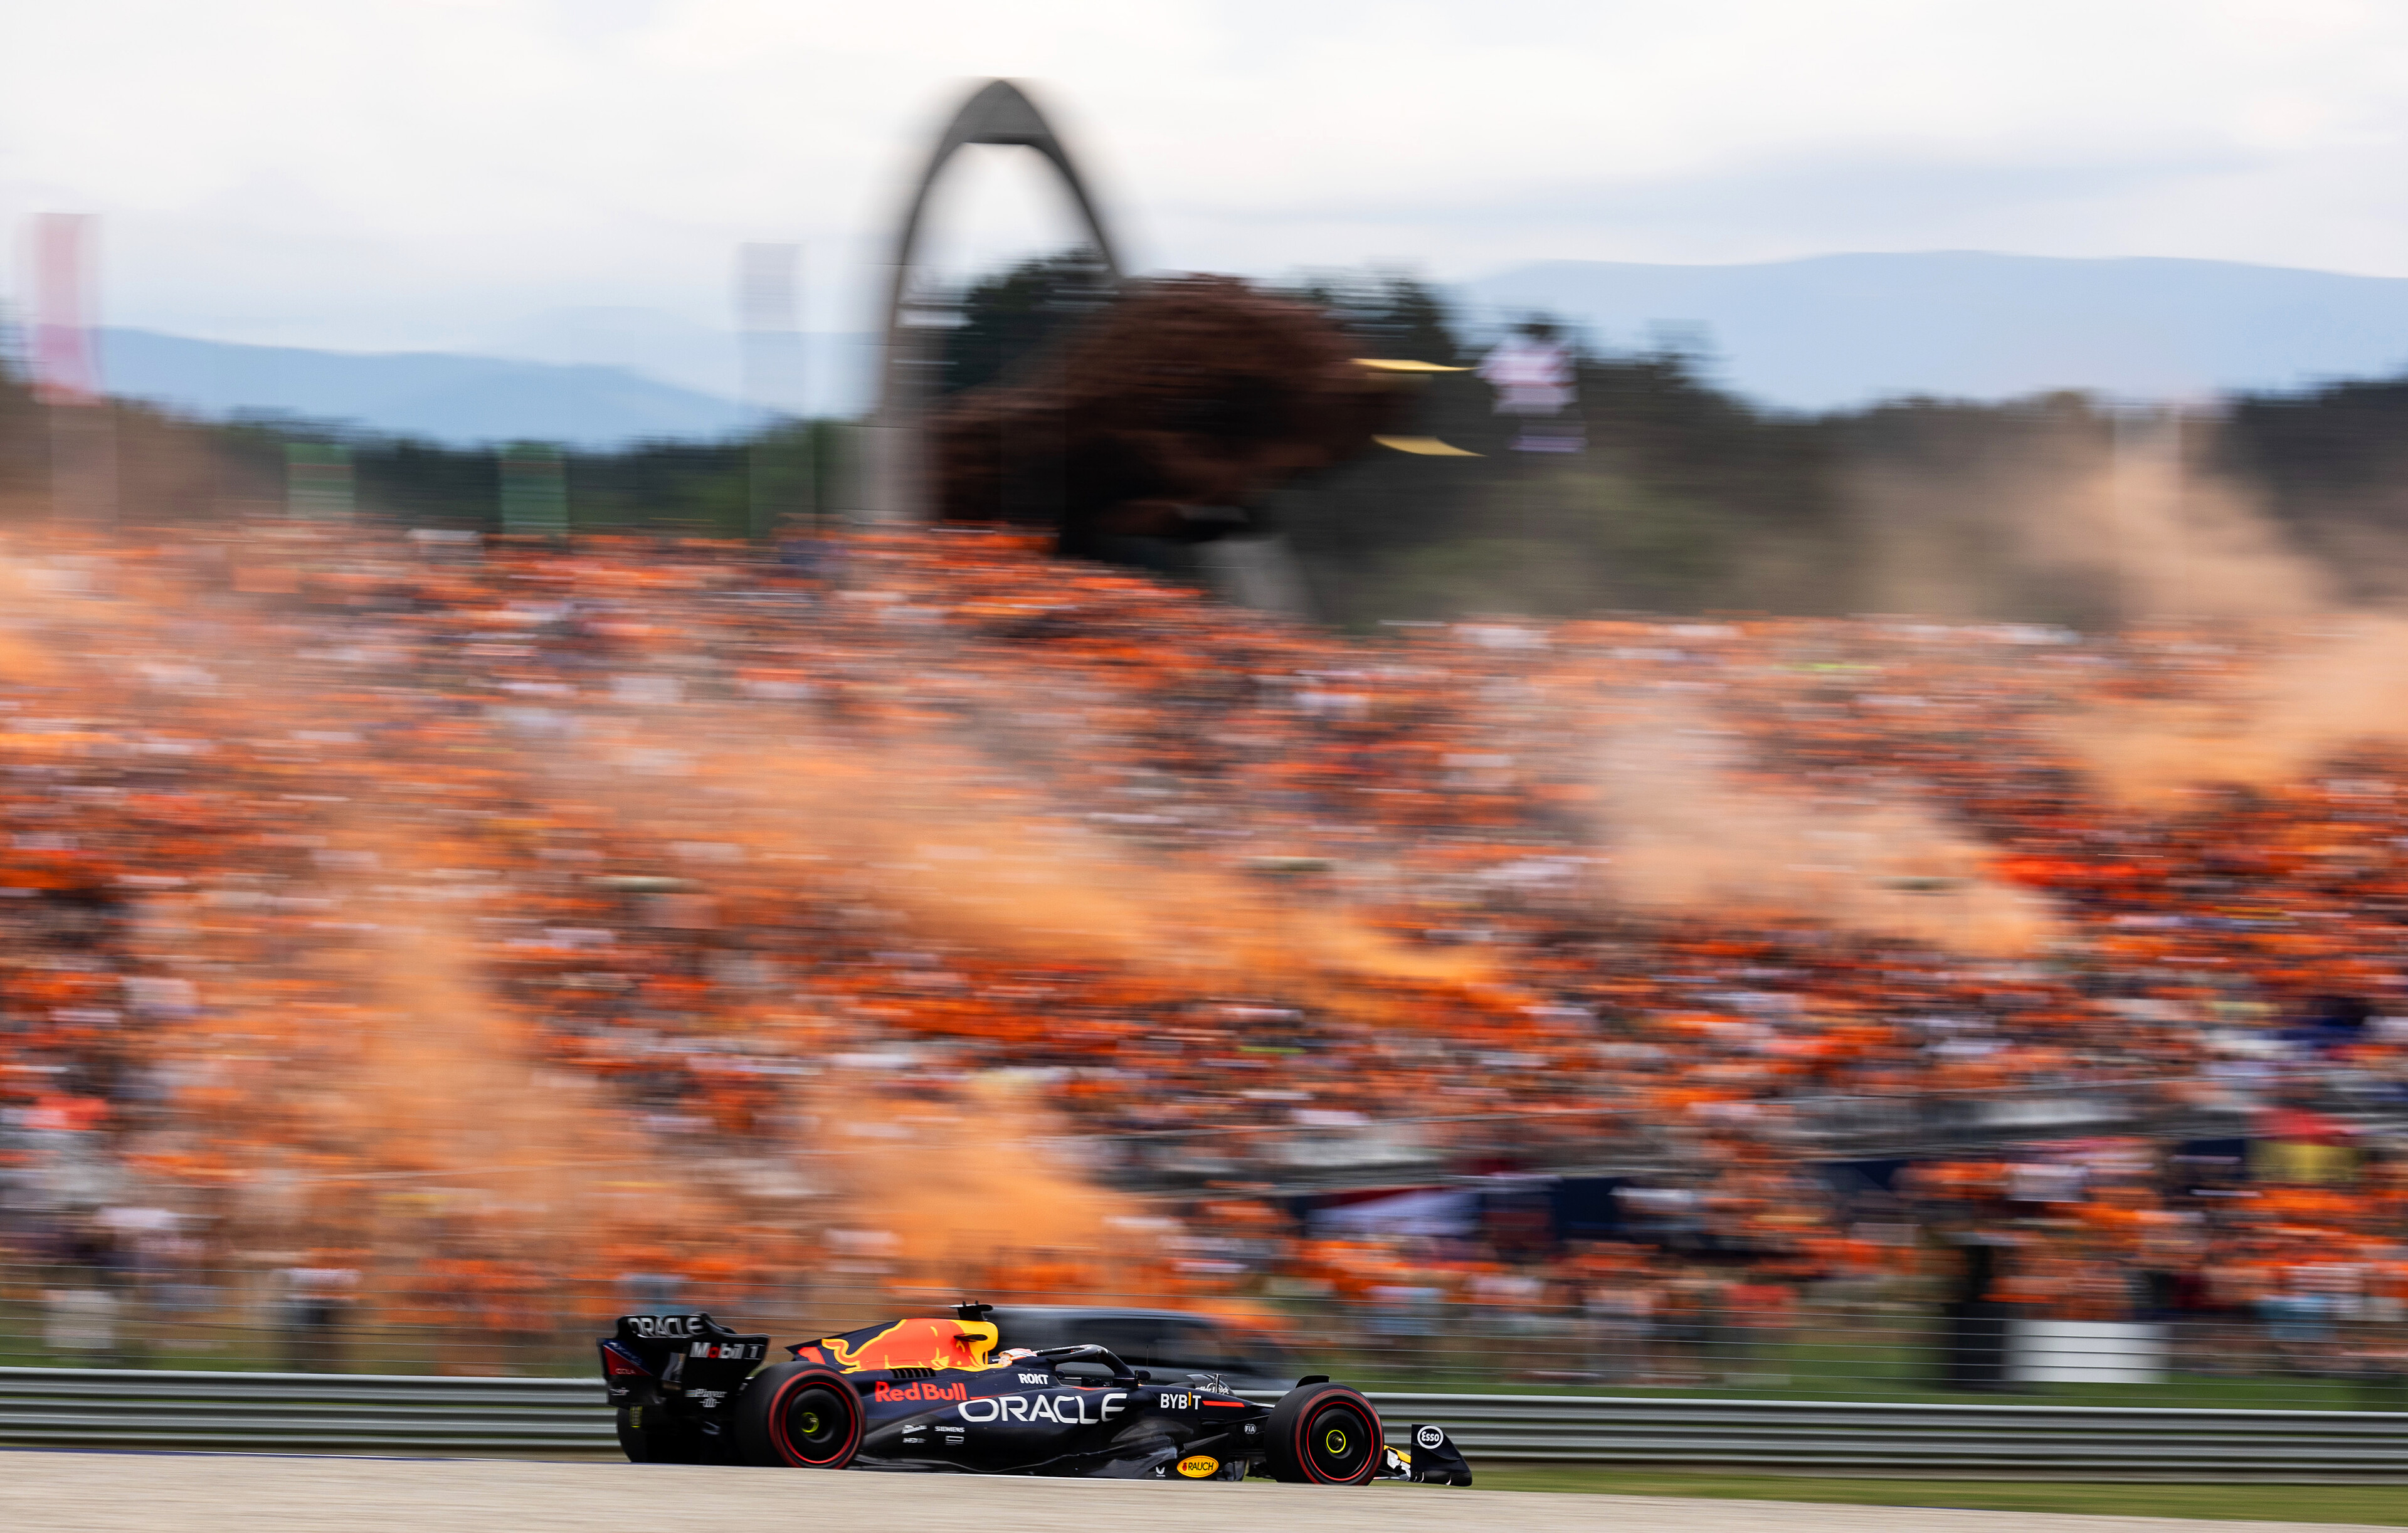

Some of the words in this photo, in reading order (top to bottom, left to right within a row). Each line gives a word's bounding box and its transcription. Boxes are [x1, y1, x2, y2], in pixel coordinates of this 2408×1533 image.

[628, 1317, 707, 1336] ORACLE
[690, 1342, 744, 1359] Mobil
[1018, 1373, 1048, 1385] ROKT
[875, 1381, 921, 1402] Red
[921, 1383, 968, 1401] Bull
[1161, 1391, 1201, 1409] BYBIT
[958, 1393, 1127, 1425] ORACLE
[1421, 1431, 1440, 1441] Esso
[1188, 1462, 1214, 1471] RAUCH
